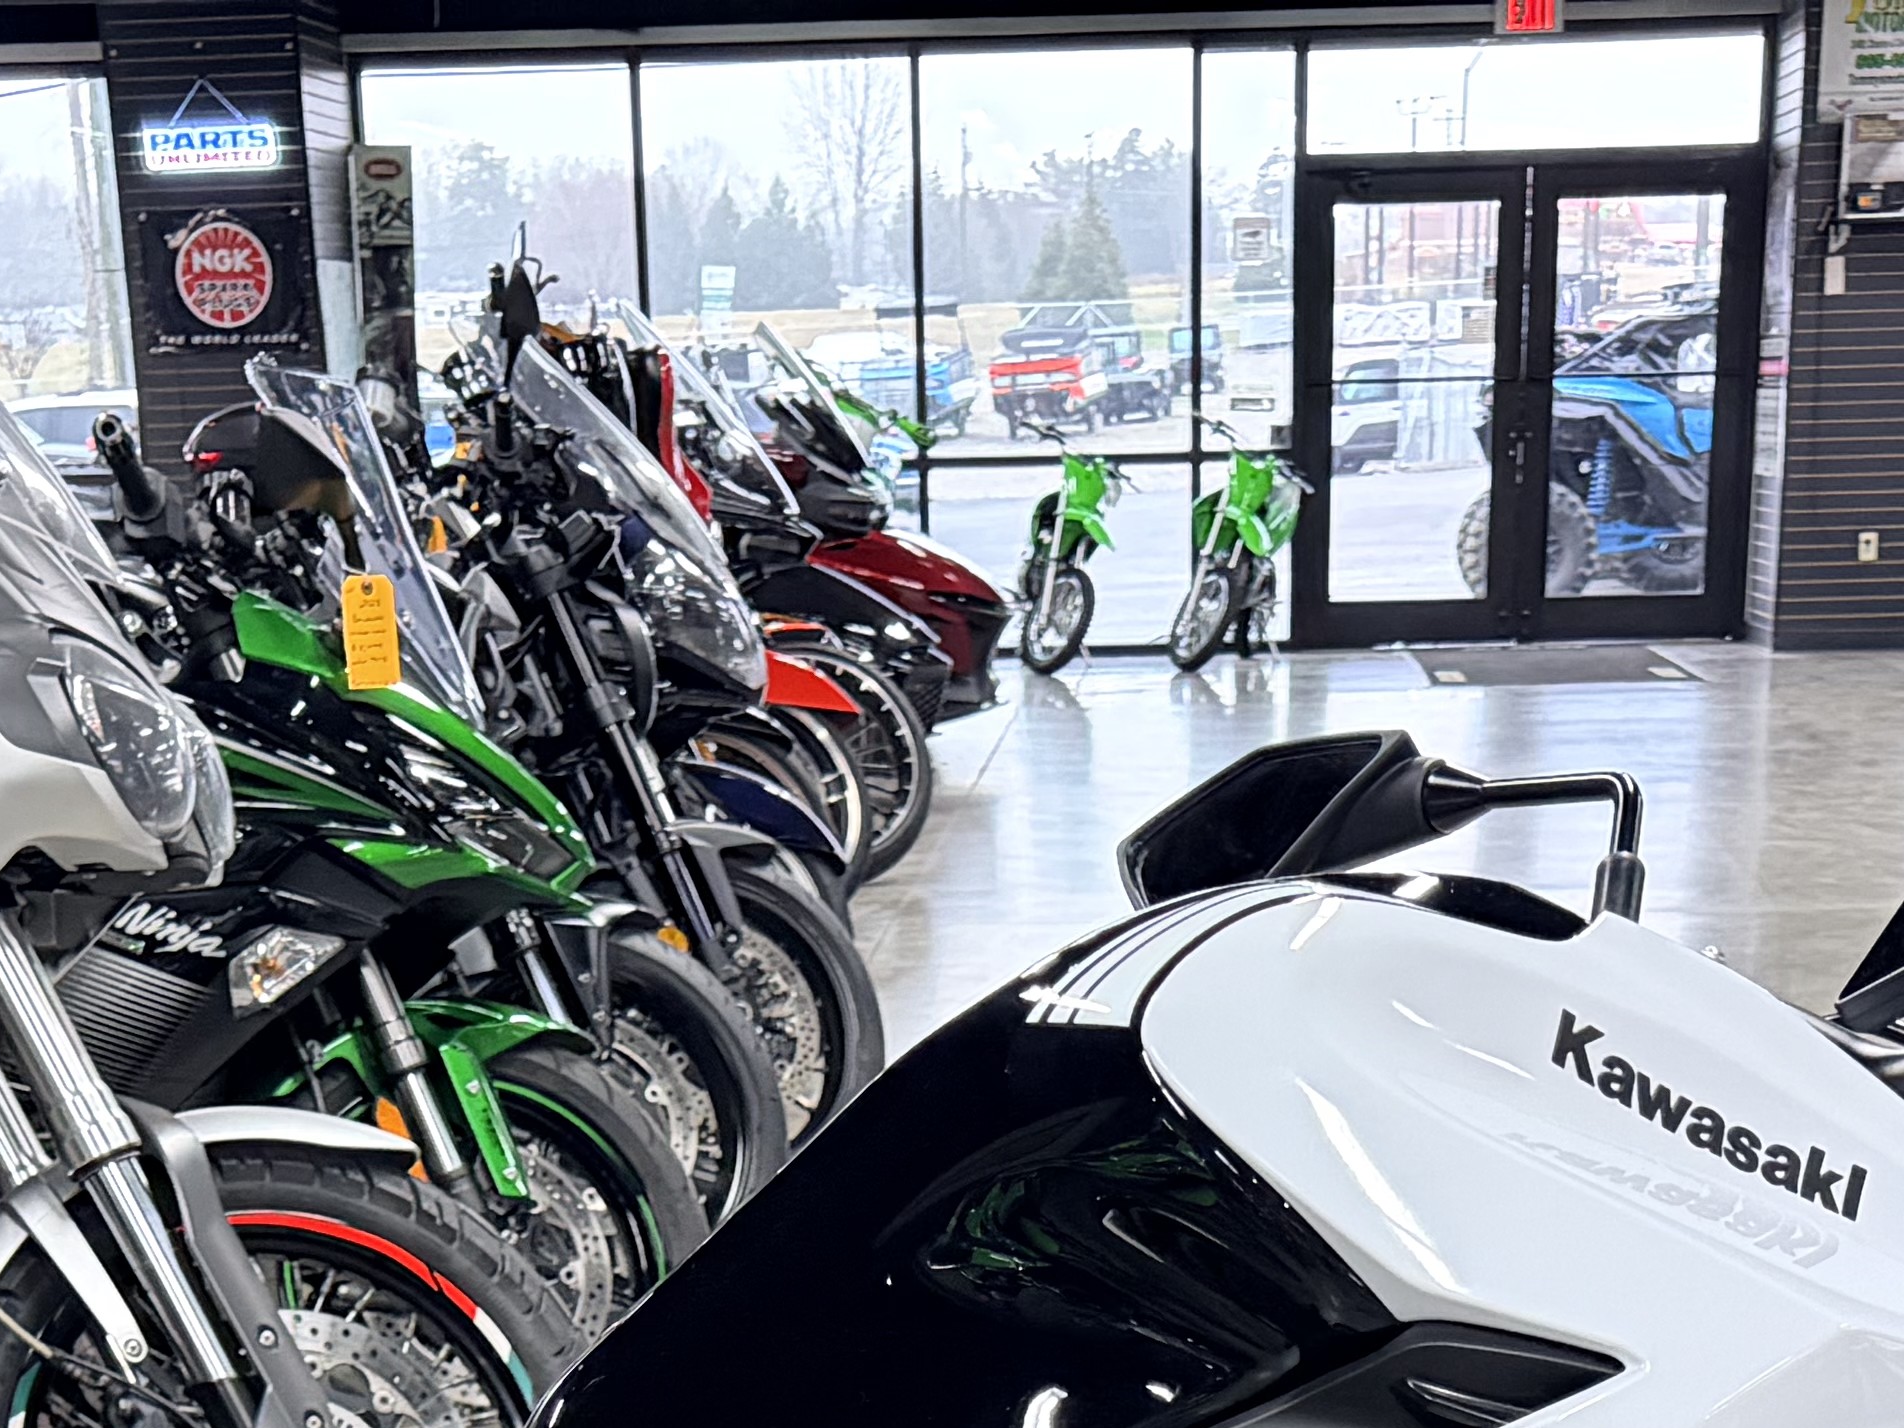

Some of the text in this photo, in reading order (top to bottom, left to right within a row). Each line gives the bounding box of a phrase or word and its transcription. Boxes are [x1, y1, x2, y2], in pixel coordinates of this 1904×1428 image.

[150, 128, 269, 152] PARTS
[191, 247, 254, 274] NGK
[114, 902, 227, 960] Ninja
[1550, 1008, 1868, 1223] Kawasaki
